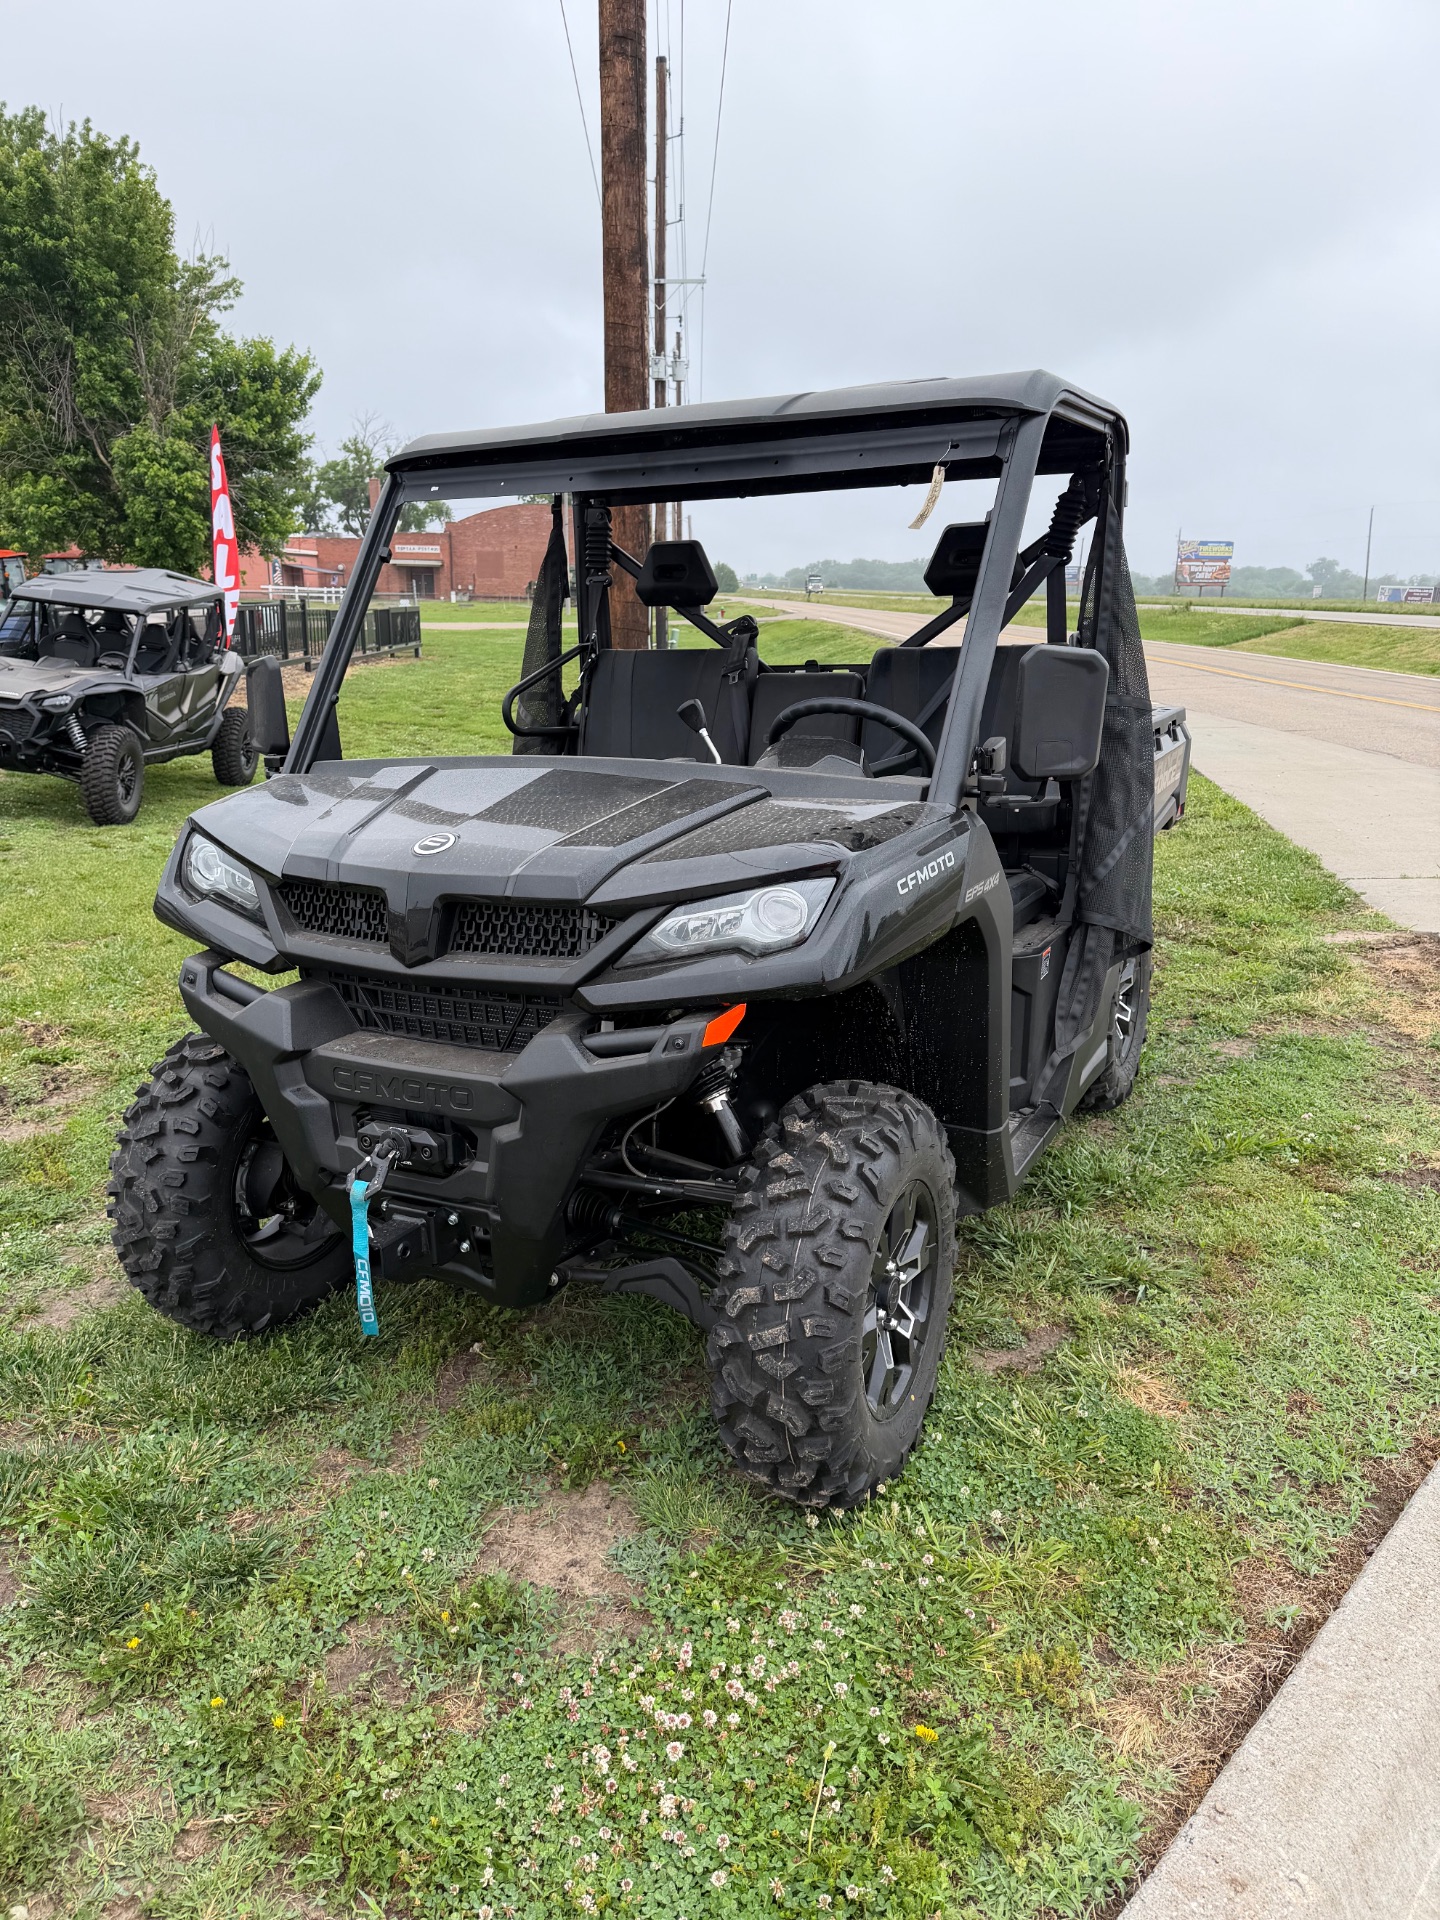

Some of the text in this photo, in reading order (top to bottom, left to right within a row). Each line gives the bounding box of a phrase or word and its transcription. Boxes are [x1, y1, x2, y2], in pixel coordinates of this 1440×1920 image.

[896, 851, 955, 895] CFMOTO
[333, 1066, 474, 1111] CFMOTO
[356, 1259, 375, 1323] CFMOTO
